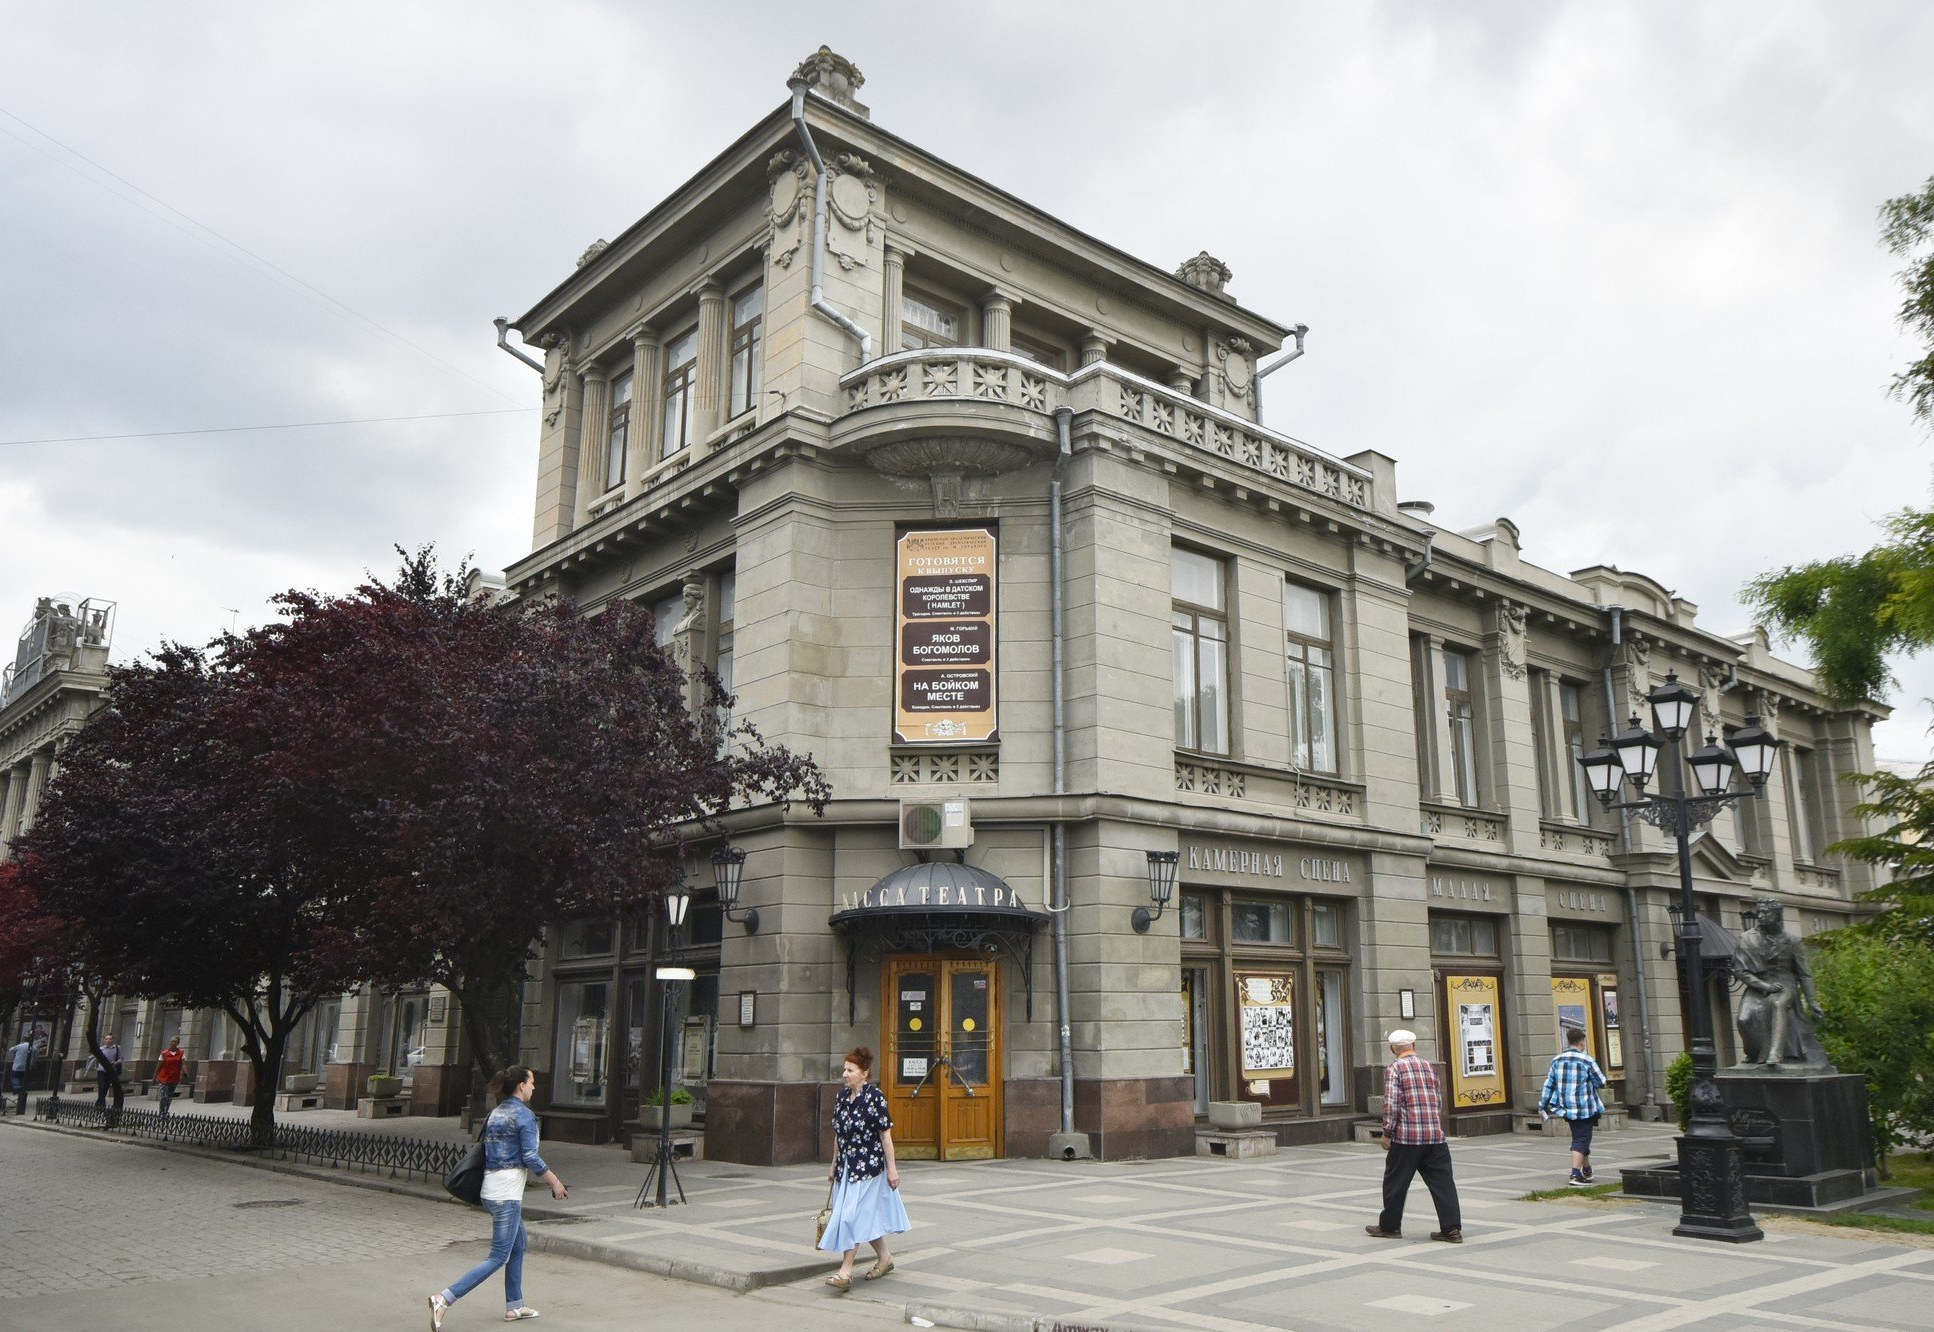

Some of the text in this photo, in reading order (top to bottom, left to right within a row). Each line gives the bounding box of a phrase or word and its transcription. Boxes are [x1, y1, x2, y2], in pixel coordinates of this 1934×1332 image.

[909, 557, 985, 566] ГОТОВЯТСЯ
[932, 634, 960, 642] ЯКОВ
[913, 645, 979, 654] БОГОМОЛОВ
[914, 680, 978, 690] НА БОЙКОМ
[927, 692, 964, 700] МЕСТЕ
[1188, 846, 1350, 883] КАМЕРНАЯ СЦЕНА
[1432, 877, 1490, 901] МАЛАЯ
[919, 886, 1017, 908] ТЕАТРА
[1559, 892, 1606, 912] СЦЕНА
